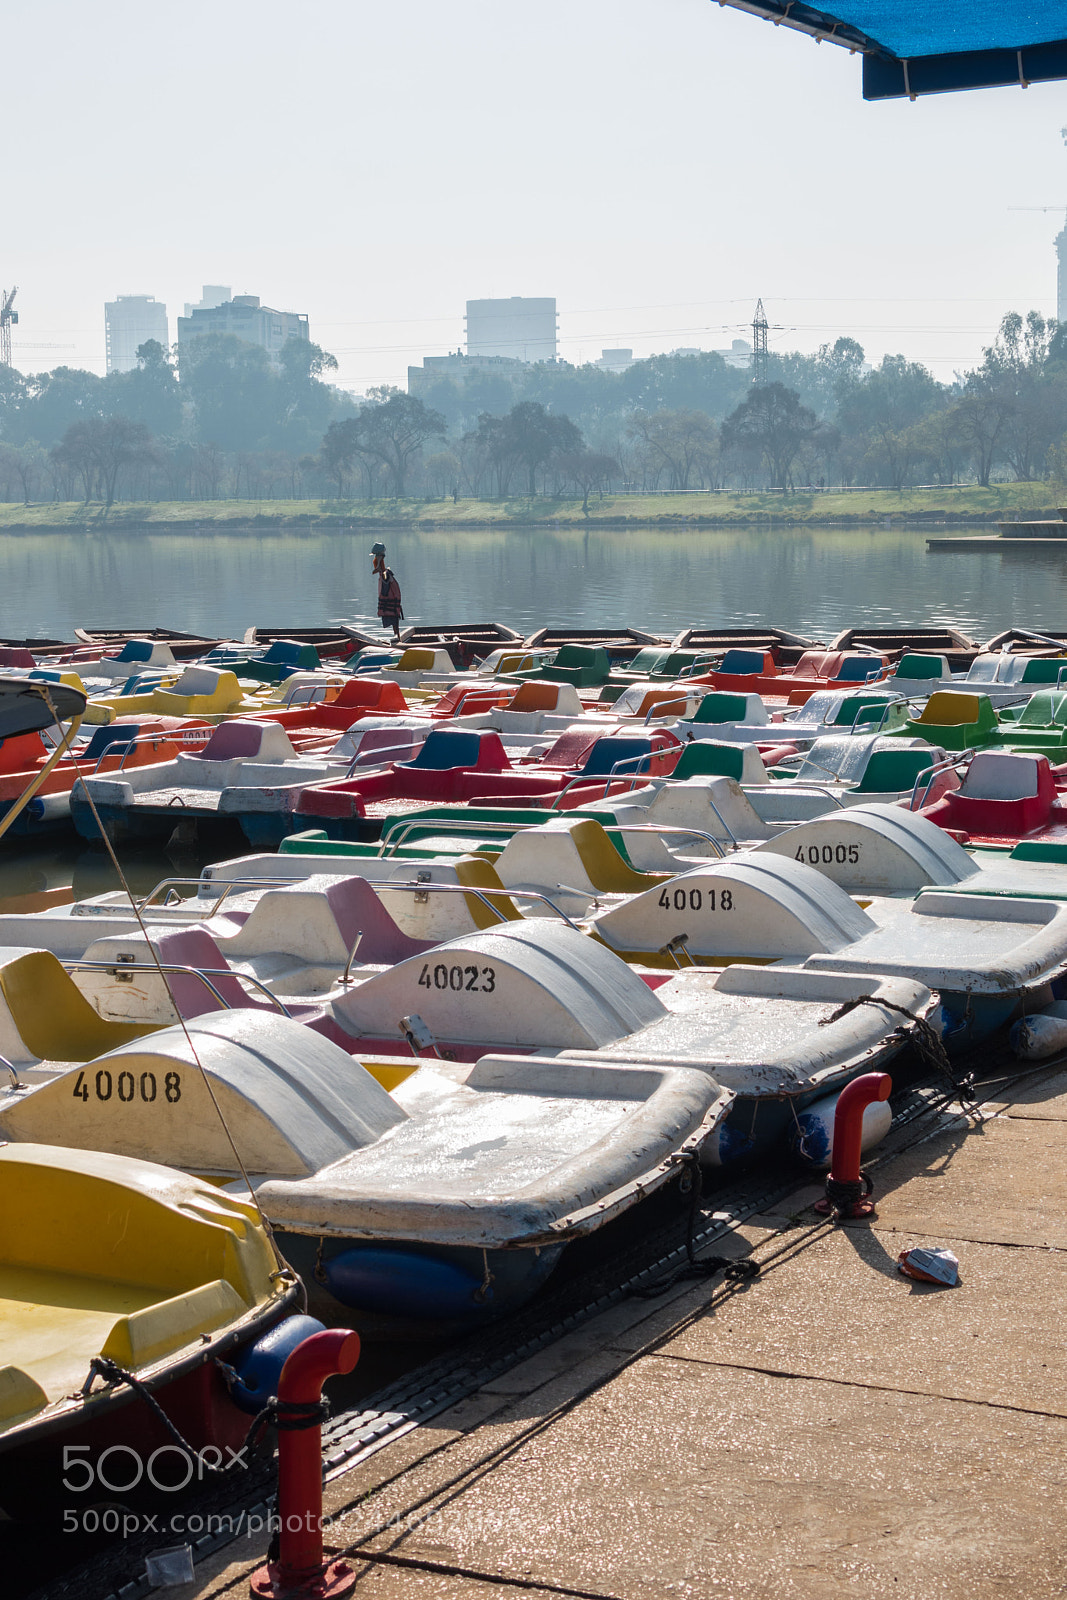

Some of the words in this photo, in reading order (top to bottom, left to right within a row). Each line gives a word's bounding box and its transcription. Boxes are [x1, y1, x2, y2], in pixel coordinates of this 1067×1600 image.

[795, 844, 859, 864] 40005
[658, 888, 733, 911] 40018
[418, 963, 496, 993] 40023
[73, 1070, 181, 1103] 40008
